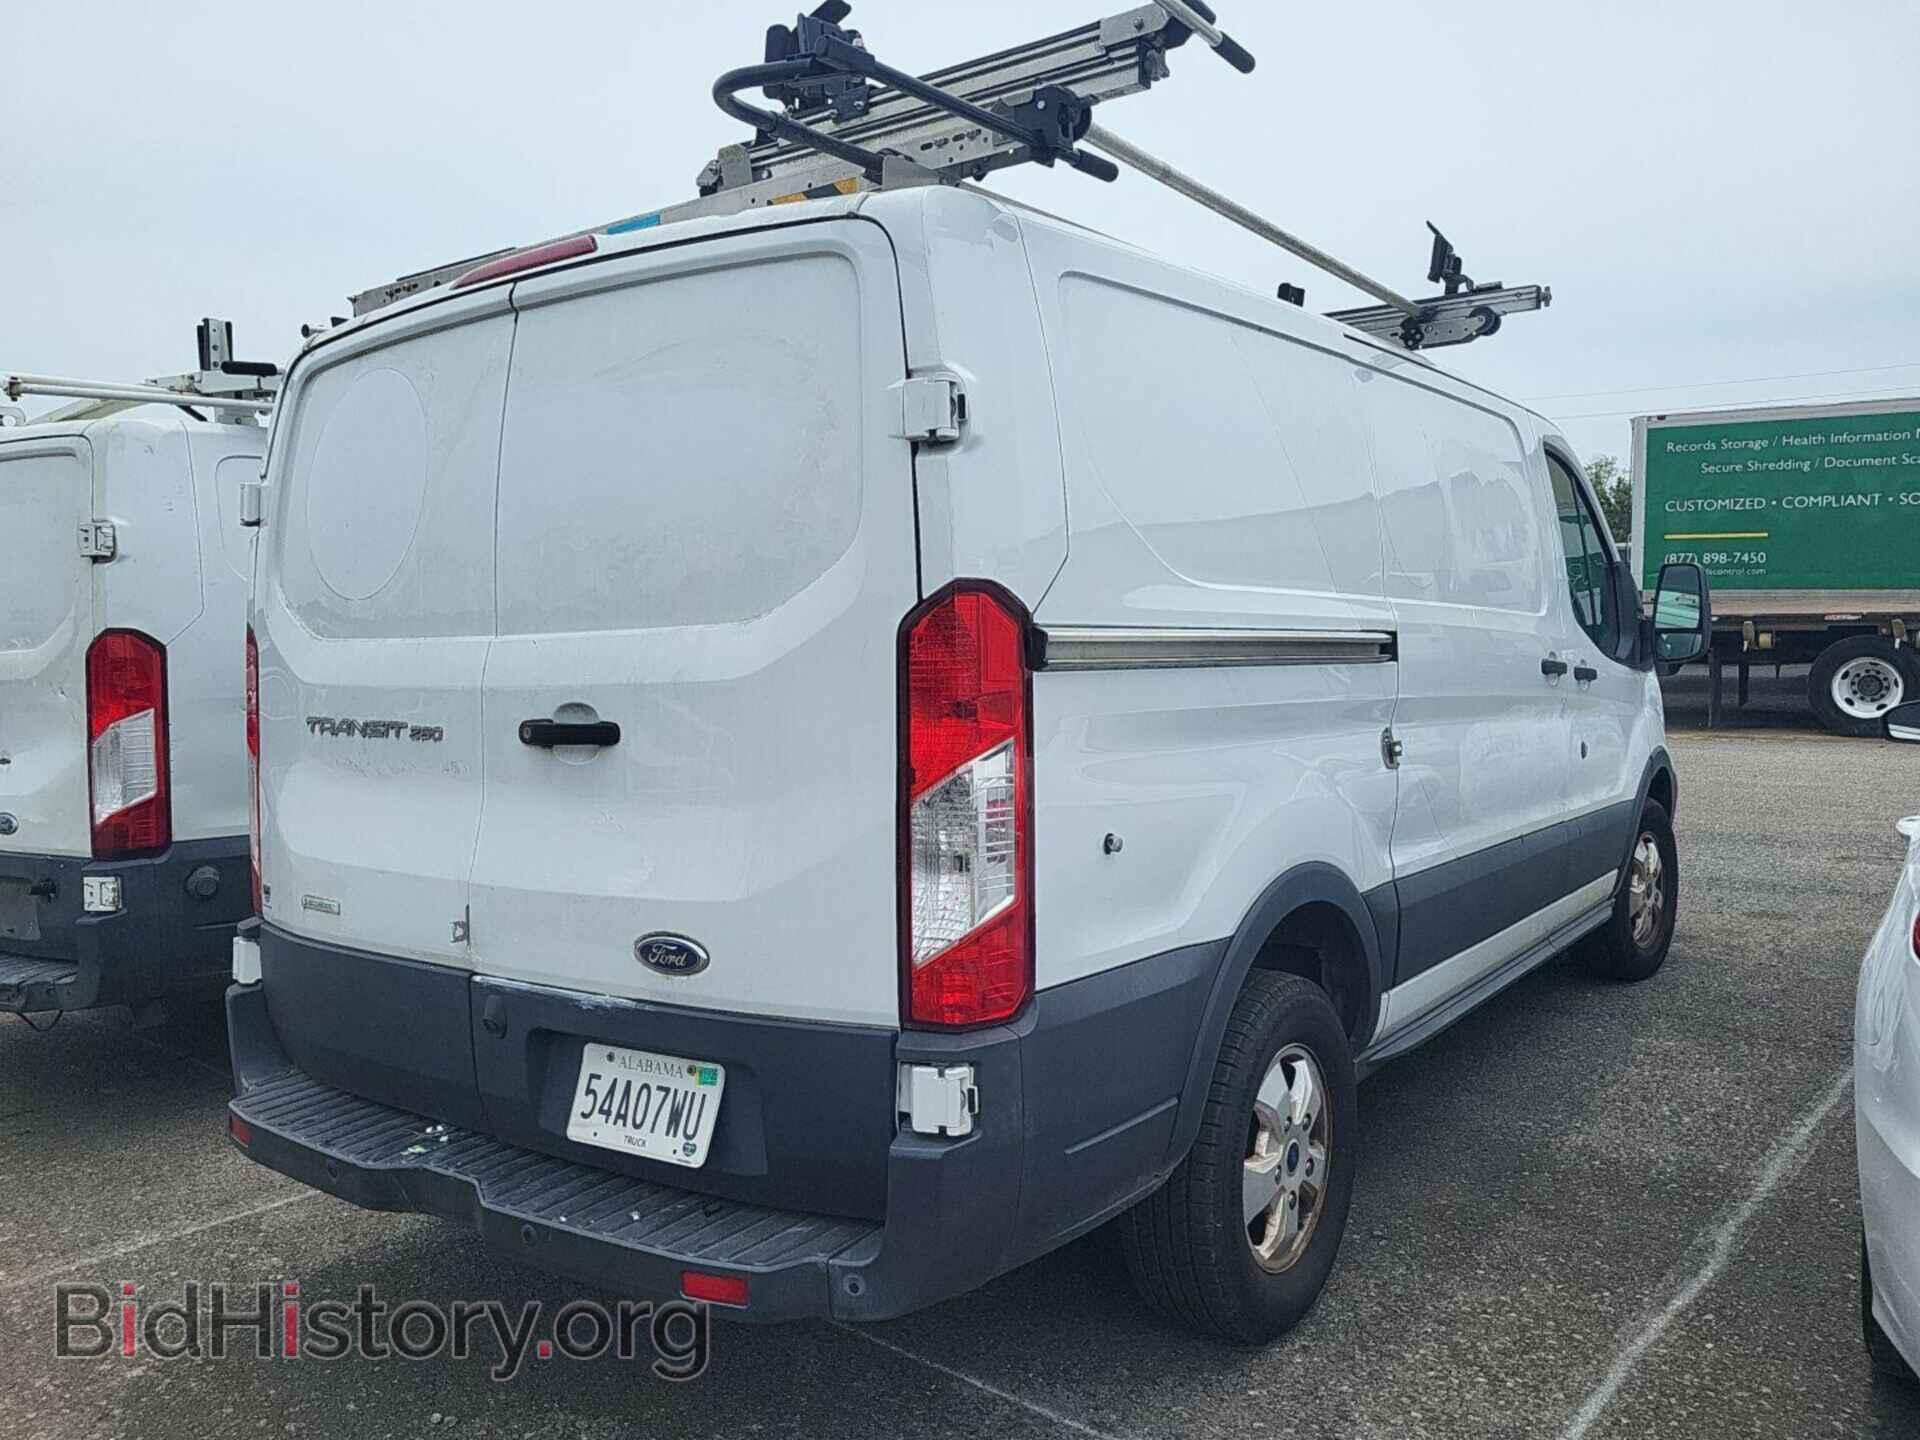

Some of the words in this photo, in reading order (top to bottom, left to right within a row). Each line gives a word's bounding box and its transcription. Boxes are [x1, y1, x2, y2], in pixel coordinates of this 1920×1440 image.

[1666, 440, 1717, 453] Records
[1721, 438, 1769, 451] Storage
[1782, 433, 1826, 447] Health
[1830, 431, 1911, 444] Information
[1701, 462, 1743, 474] Secure
[1747, 458, 1811, 473] Shredding
[1824, 456, 1897, 468] Document
[1665, 497, 1767, 512] CUSTOMIZED
[1782, 493, 1882, 508] COMPLIANT
[1664, 552, 1698, 565] (877)
[1702, 551, 1767, 564] 898-7450
[306, 716, 408, 740] TRANSIT
[648, 943, 688, 967] Ford
[618, 1055, 683, 1079] ALABAMA
[580, 1072, 707, 1141] 54A07WU
[623, 1135, 647, 1148] TRUCK
